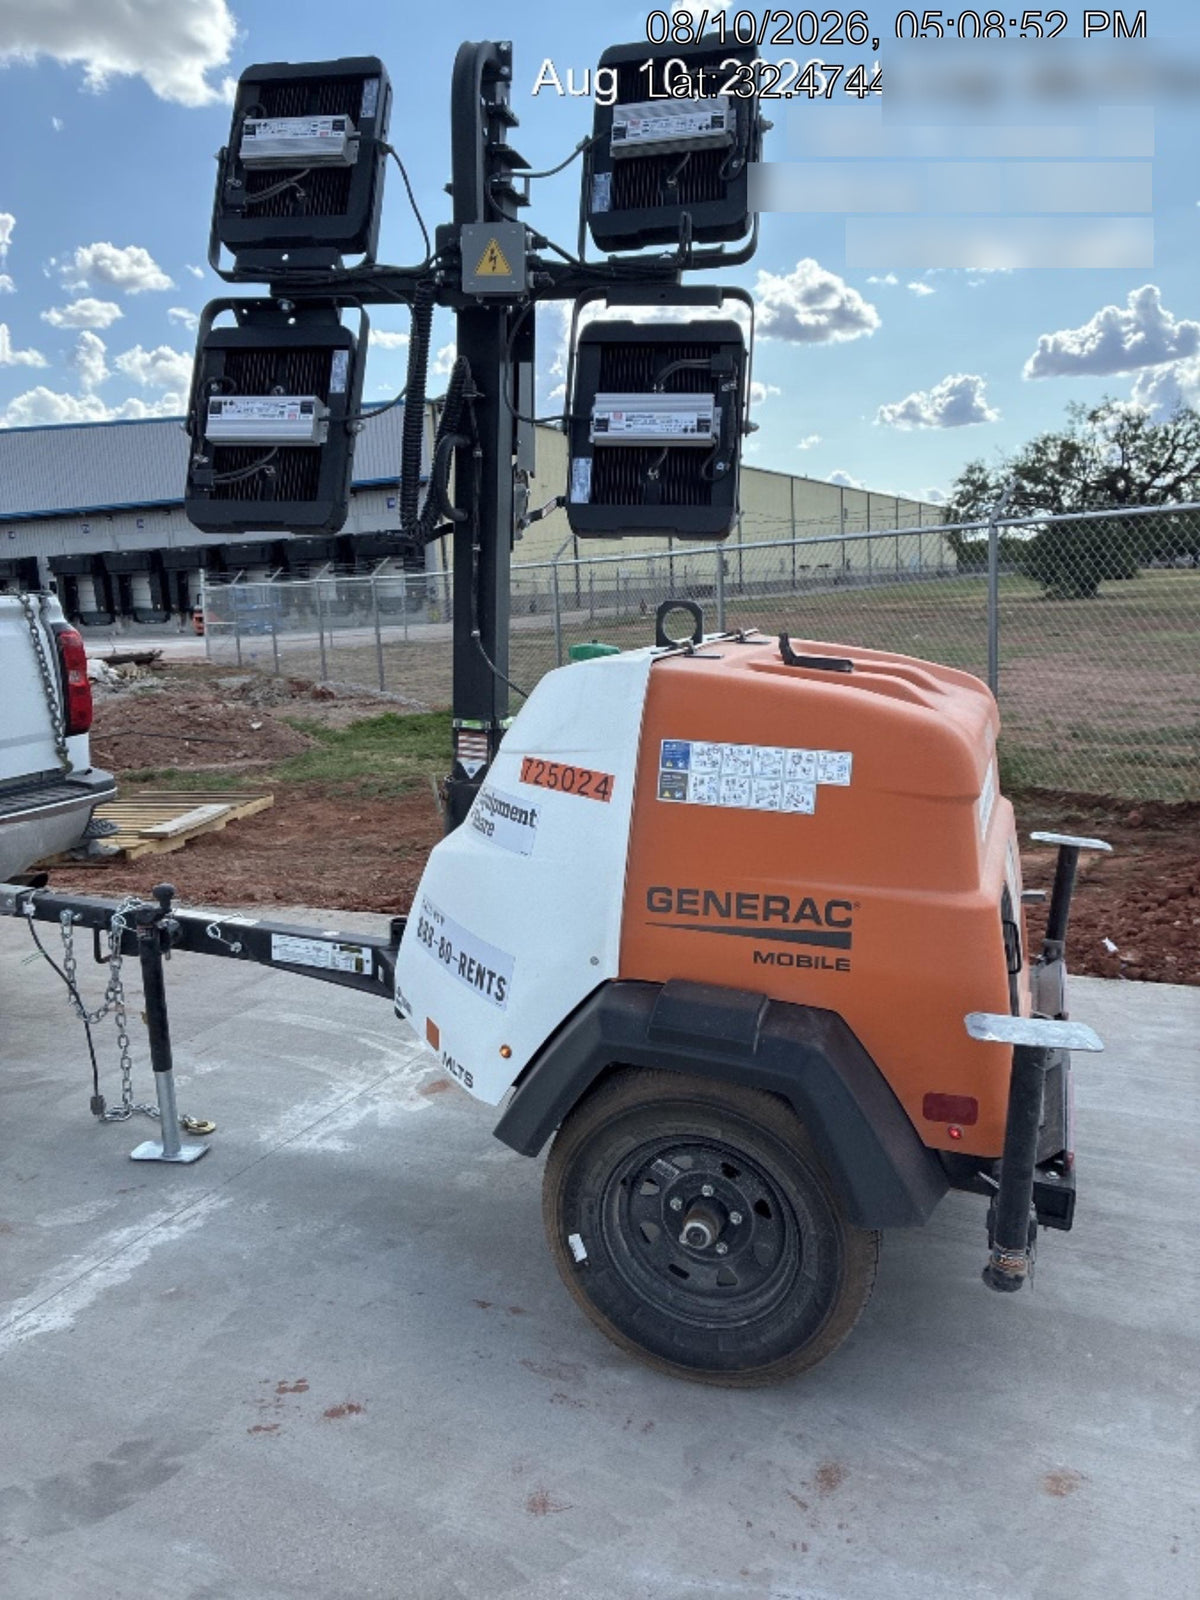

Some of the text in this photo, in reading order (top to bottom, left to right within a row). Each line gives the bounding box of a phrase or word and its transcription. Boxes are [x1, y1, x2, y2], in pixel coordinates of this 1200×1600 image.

[522, 757, 609, 800] 725024
[646, 886, 853, 928] GENERAC
[753, 950, 851, 972] MOBILE
